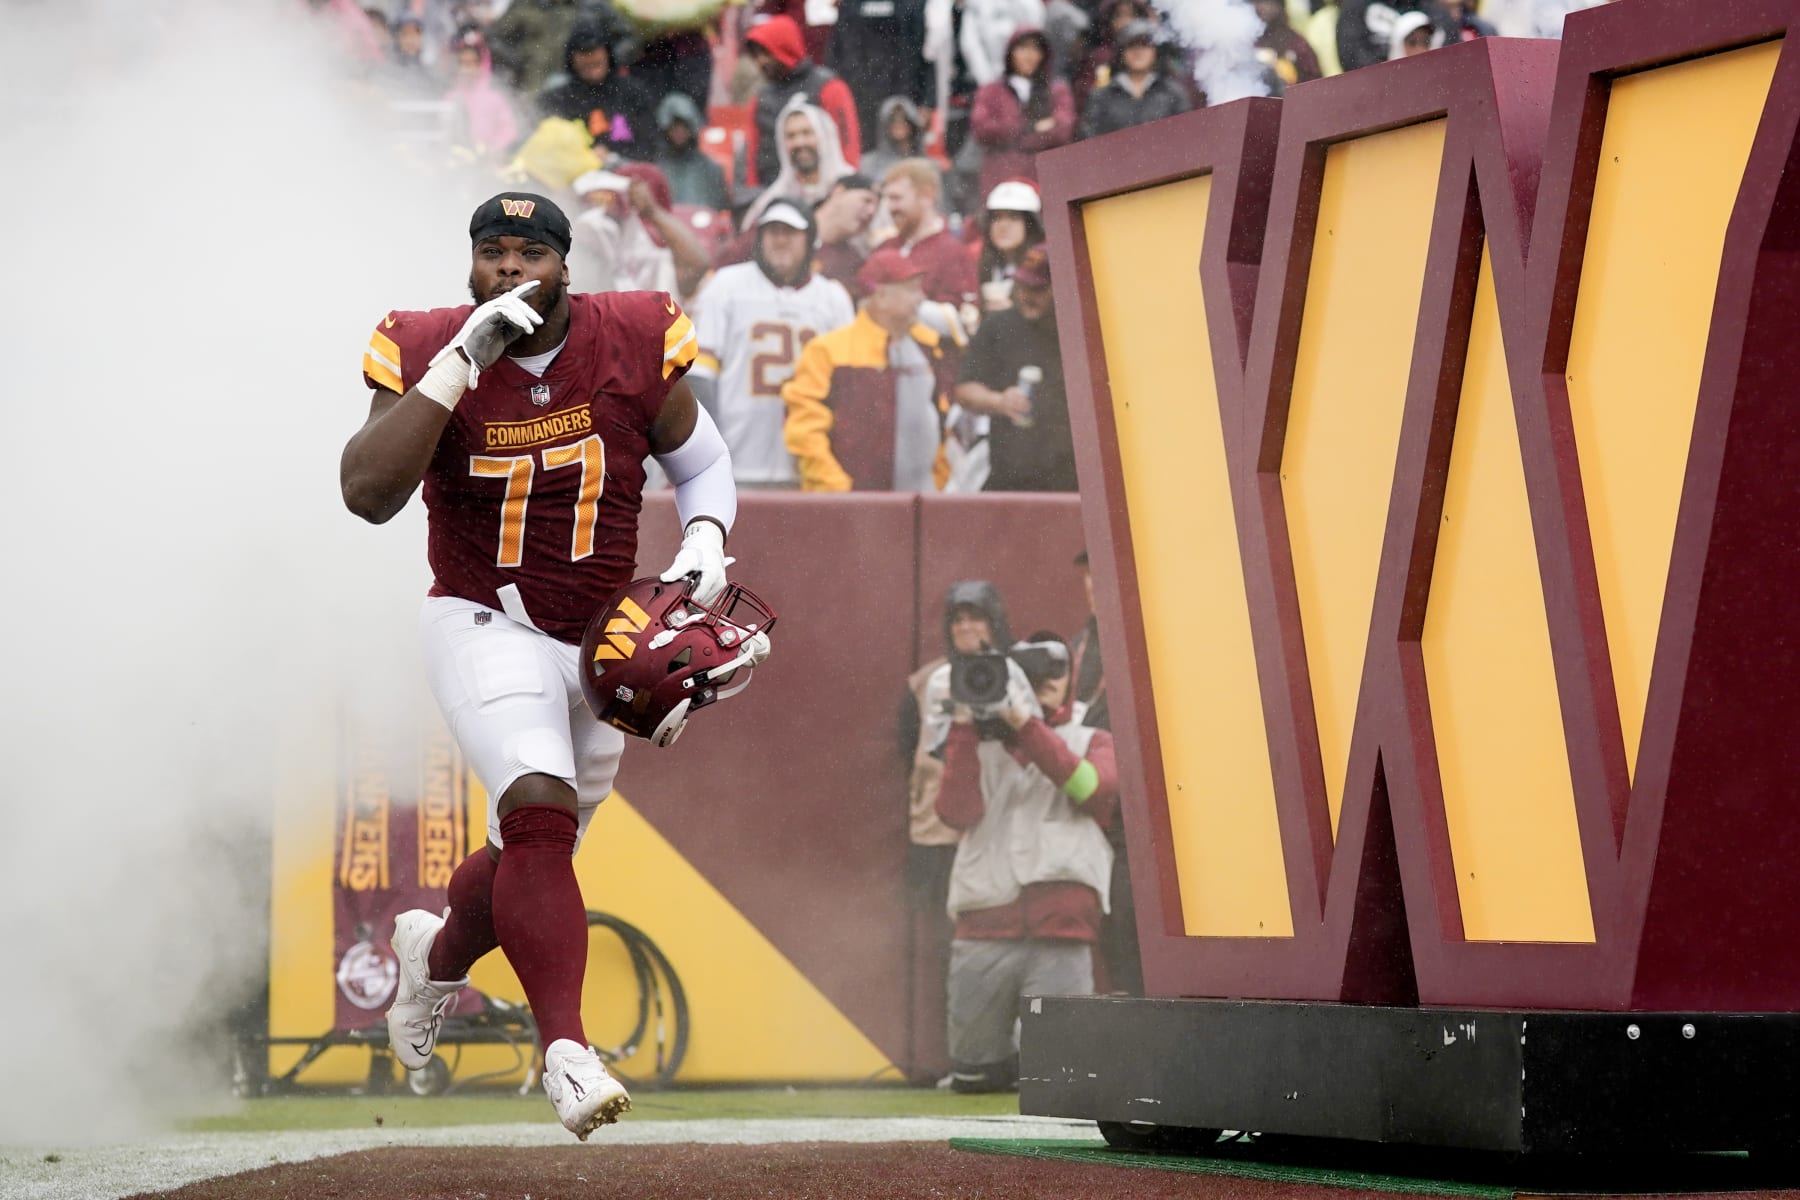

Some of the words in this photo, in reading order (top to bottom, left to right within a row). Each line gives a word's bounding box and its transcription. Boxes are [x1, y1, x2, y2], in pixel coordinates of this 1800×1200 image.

[748, 320, 817, 396] 2
[486, 409, 592, 446] COMMANDERS
[469, 433, 605, 567] 77
